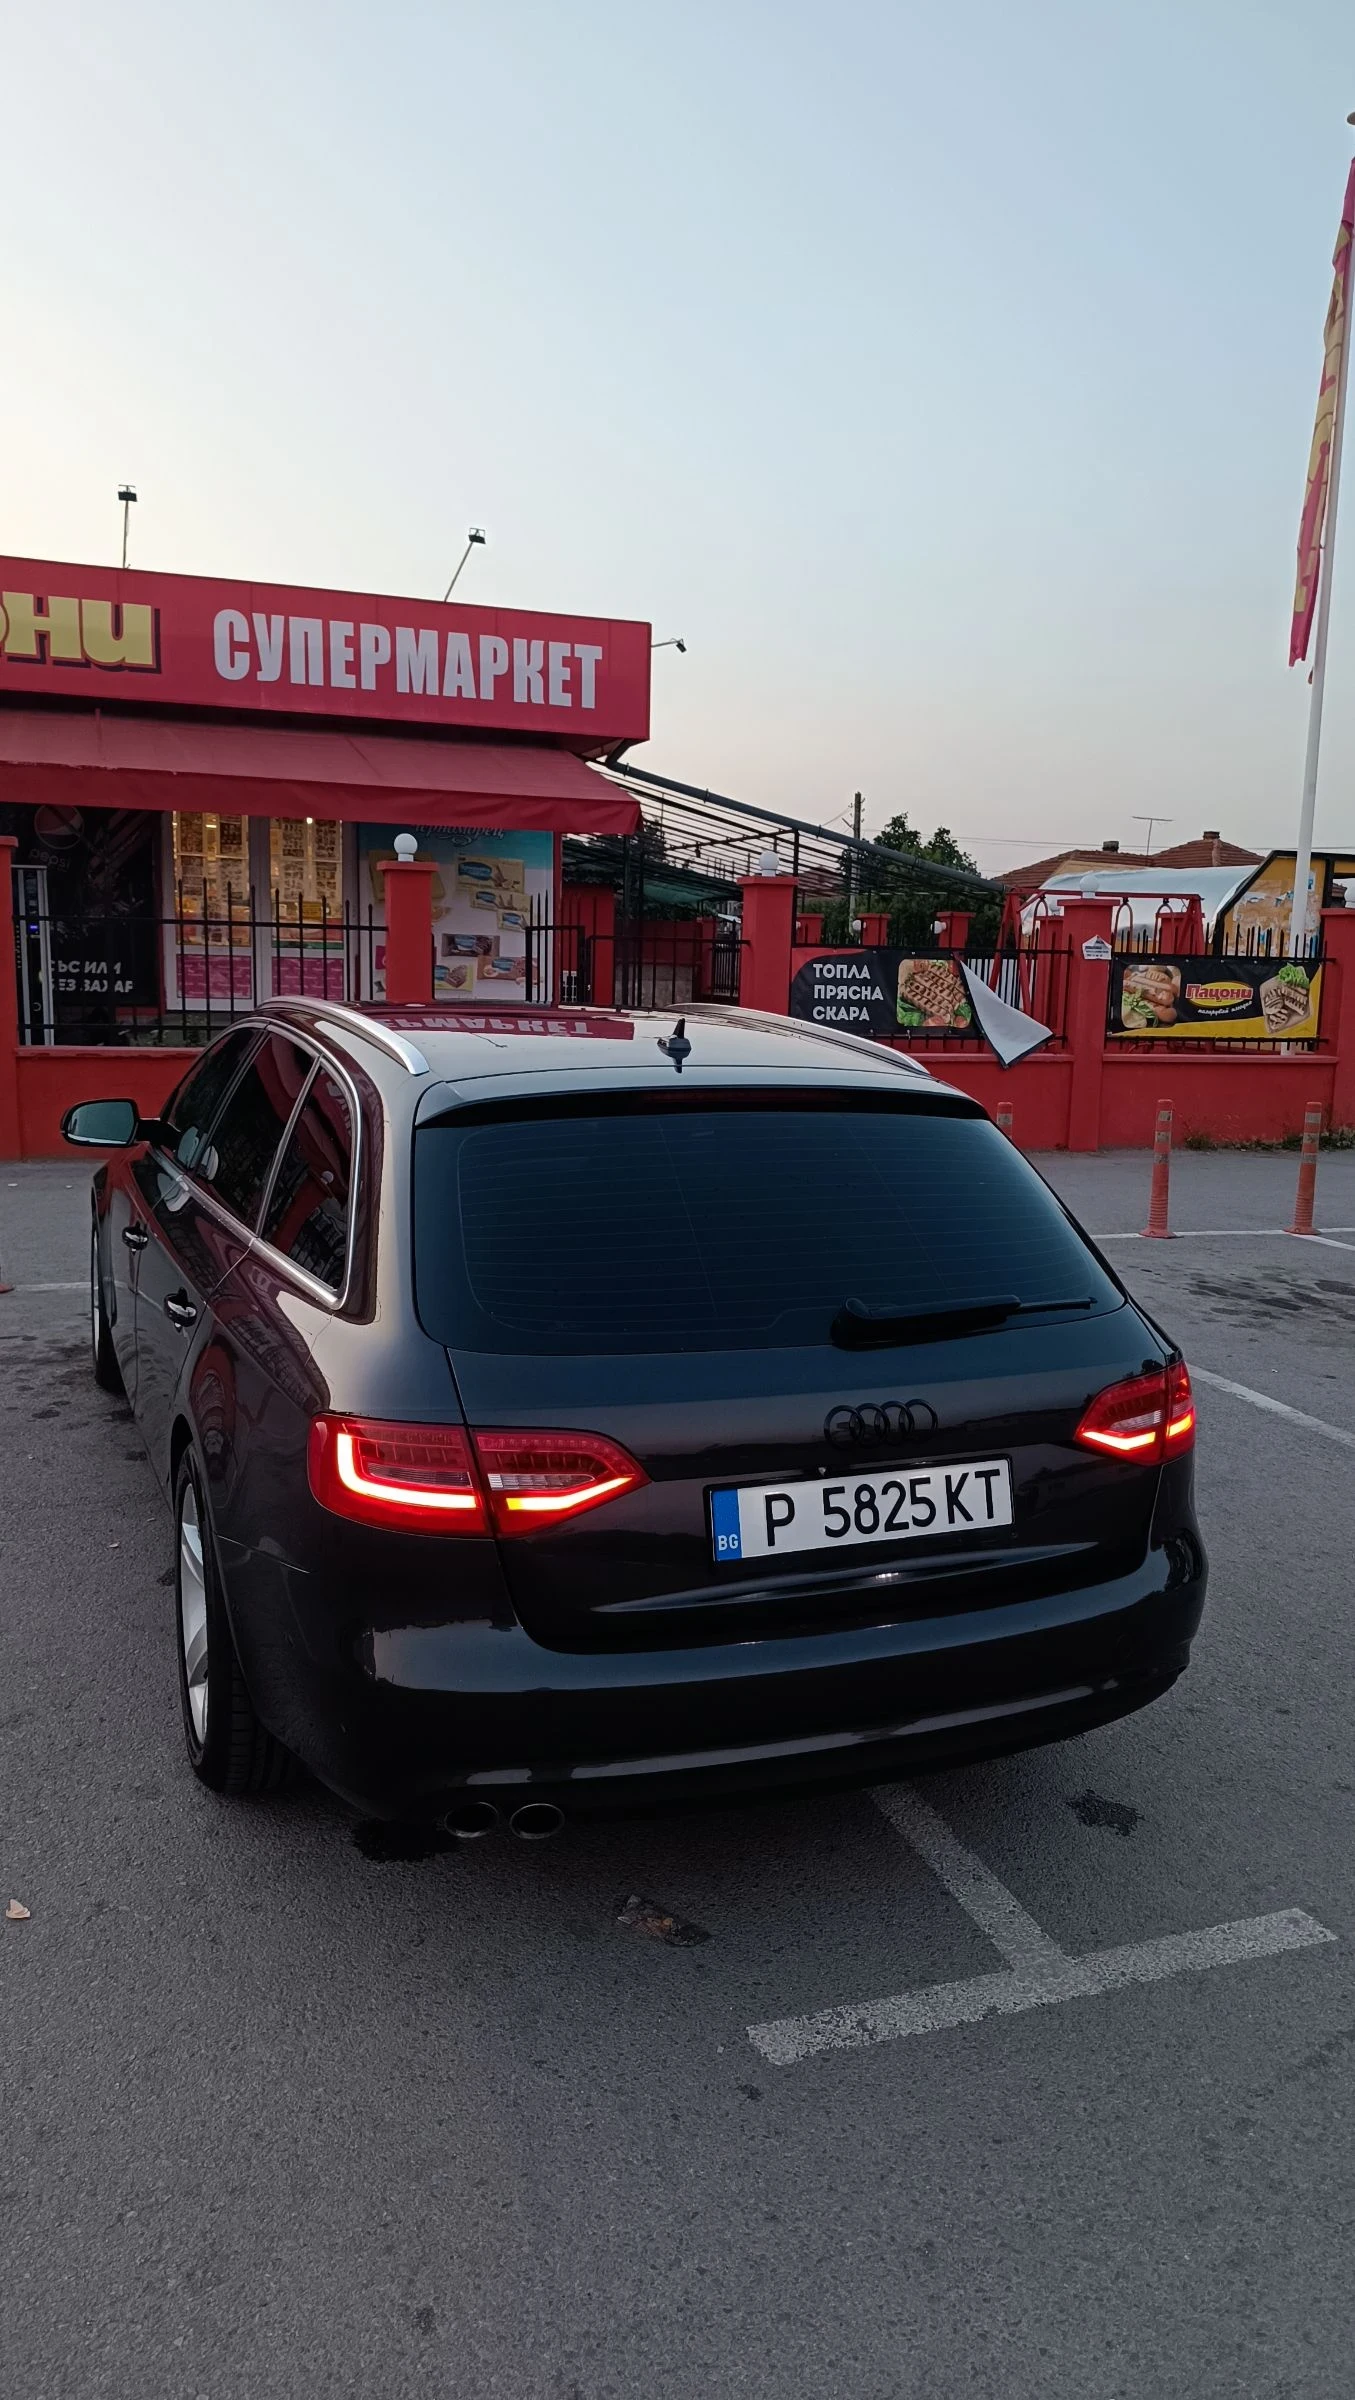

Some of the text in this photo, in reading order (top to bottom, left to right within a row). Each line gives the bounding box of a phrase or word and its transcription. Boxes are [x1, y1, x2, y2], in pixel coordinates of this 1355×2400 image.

[0, 590, 155, 668] ни
[213, 608, 603, 709] СУПЕРМАРКЕТ
[812, 963, 872, 980] ТОПЛА
[51, 978, 77, 991] ЕЗ
[813, 984, 884, 1002] ПРЯСНА
[1186, 984, 1254, 1002] Пацони
[812, 1004, 871, 1022] СКАРА
[764, 1493, 796, 1547] P
[717, 1533, 739, 1552] BG
